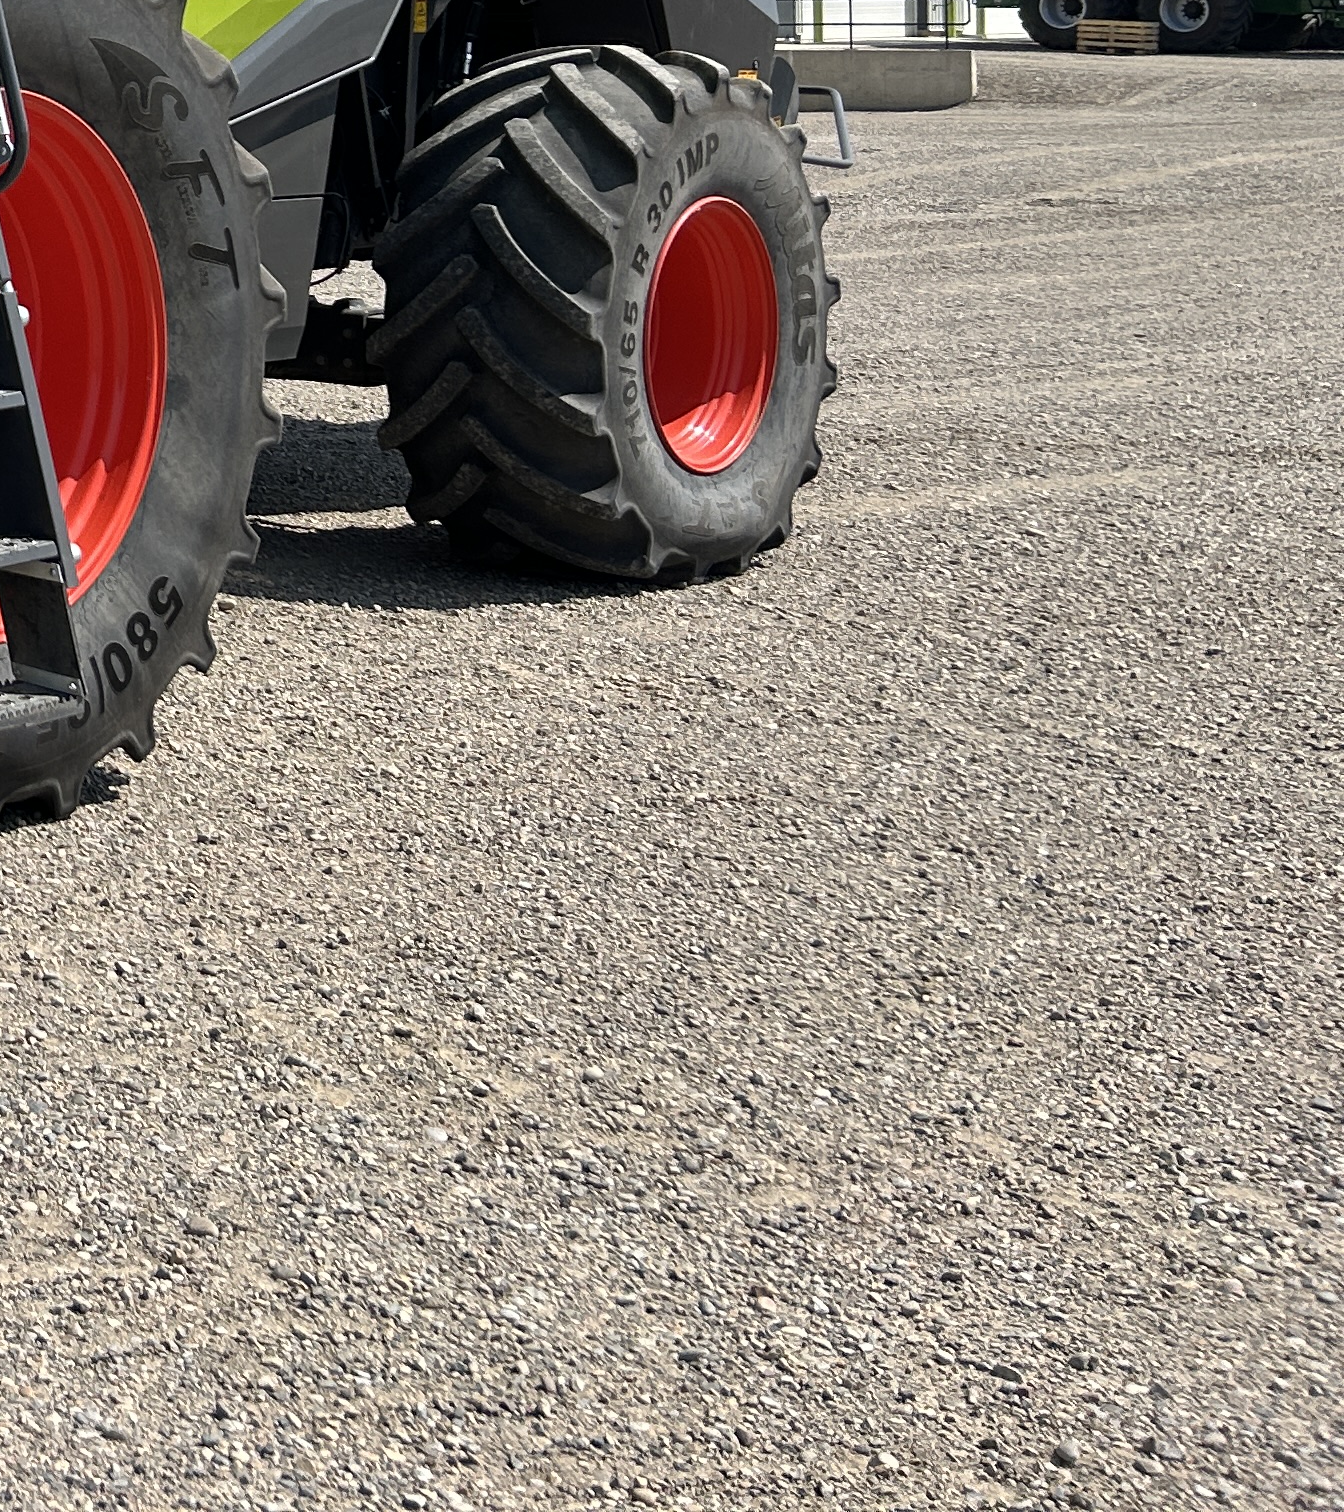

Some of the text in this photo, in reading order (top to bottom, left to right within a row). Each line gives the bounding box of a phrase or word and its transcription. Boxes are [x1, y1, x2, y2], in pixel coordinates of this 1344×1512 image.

[631, 243, 650, 278] R
[647, 180, 673, 234] 30
[676, 132, 720, 188] IMP
